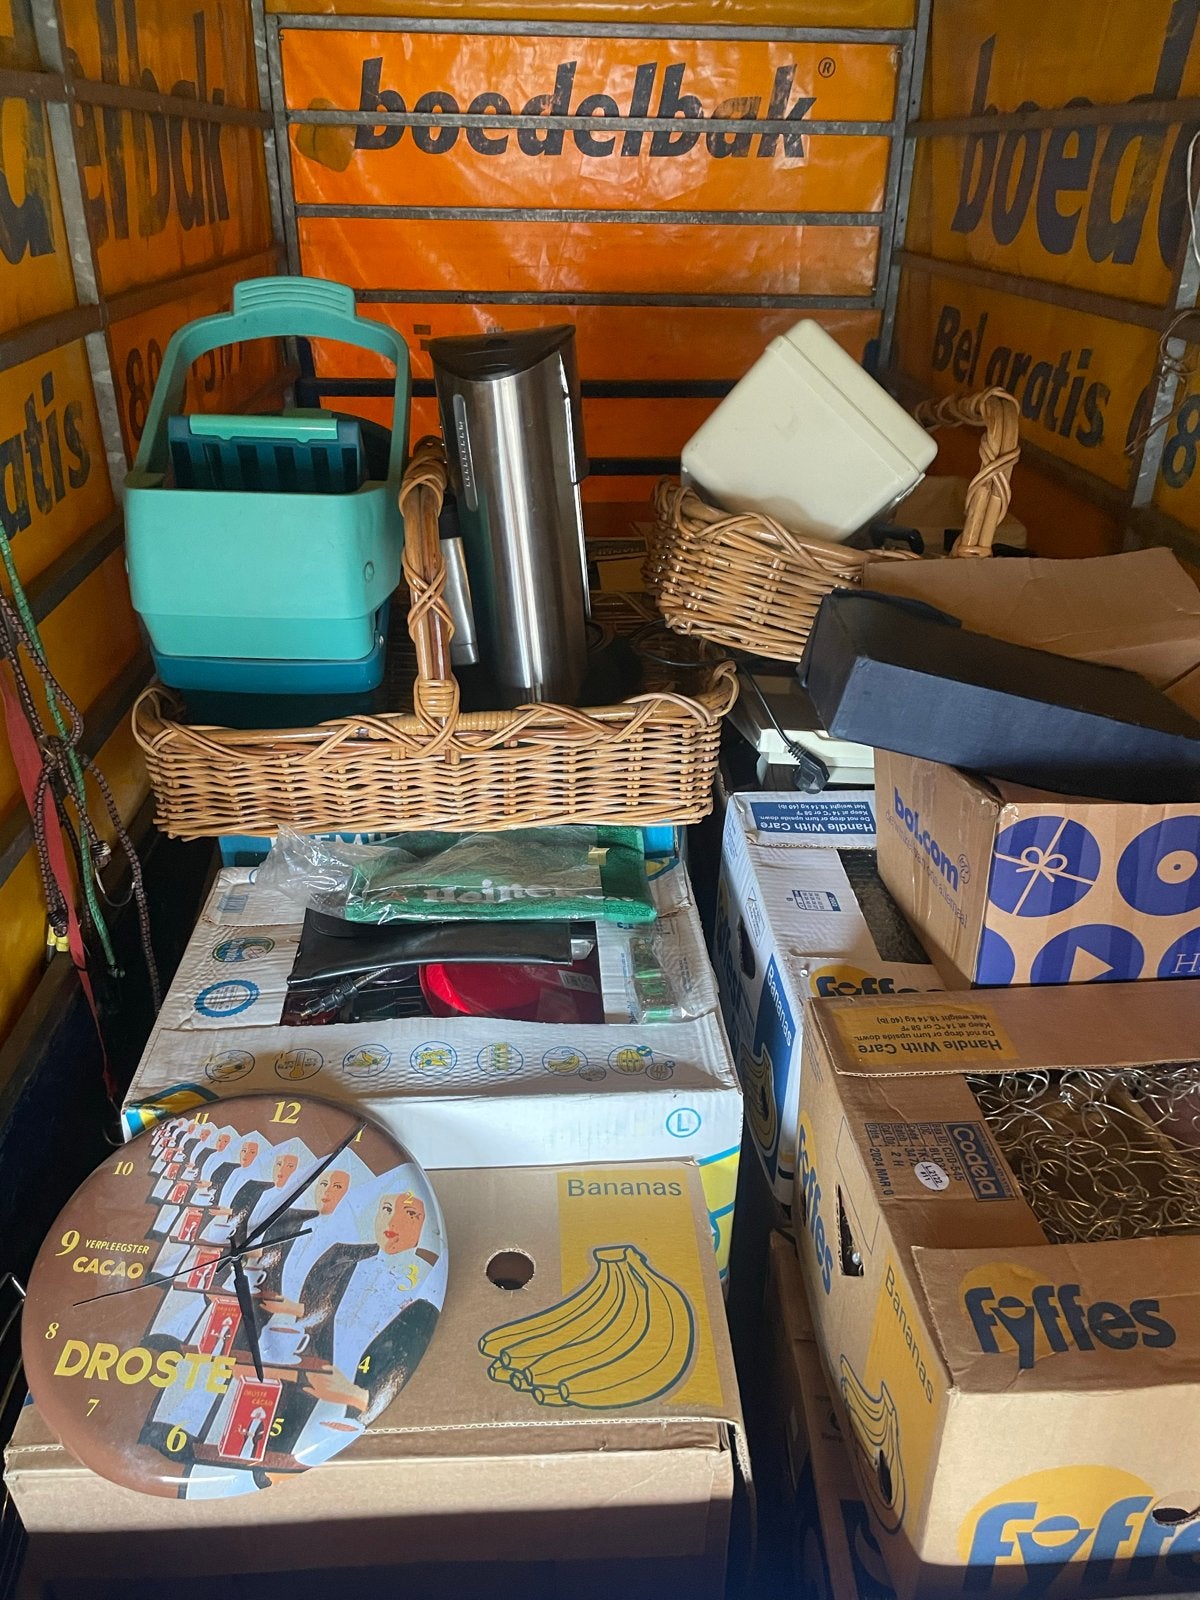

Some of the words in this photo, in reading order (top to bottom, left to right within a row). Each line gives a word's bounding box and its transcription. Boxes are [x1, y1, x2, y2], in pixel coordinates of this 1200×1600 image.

[354, 57, 817, 158] boedelbak
[931, 305, 988, 387] Bel
[760, 821, 790, 831] Care
[794, 822, 825, 832] With
[828, 823, 874, 832] Handle
[894, 786, 959, 892] bol.com
[766, 966, 793, 1047] Bananas
[858, 1043, 897, 1054] Care
[901, 1040, 941, 1053] With
[944, 1039, 1003, 1051] Handle
[193, 1113, 209, 1125] 11
[269, 1101, 301, 1125] 12
[869, 1148, 885, 1166] 2024
[953, 1127, 998, 1195] Codela
[112, 1161, 134, 1175] 10
[567, 1179, 682, 1196] Bananas
[403, 1191, 415, 1205] 2
[55, 1230, 80, 1256] 9
[85, 1239, 150, 1255] VERPLEEGSTER
[72, 1256, 144, 1279] CACAO
[397, 1264, 418, 1291] 3
[45, 1322, 60, 1340] 8
[885, 1264, 935, 1404] Bananas
[964, 1284, 1177, 1369] fyffes
[54, 1339, 237, 1394] DROSTE
[358, 1356, 371, 1374] 4
[86, 1398, 100, 1417] 7
[269, 1418, 285, 1437] 5
[165, 1425, 187, 1451] 6
